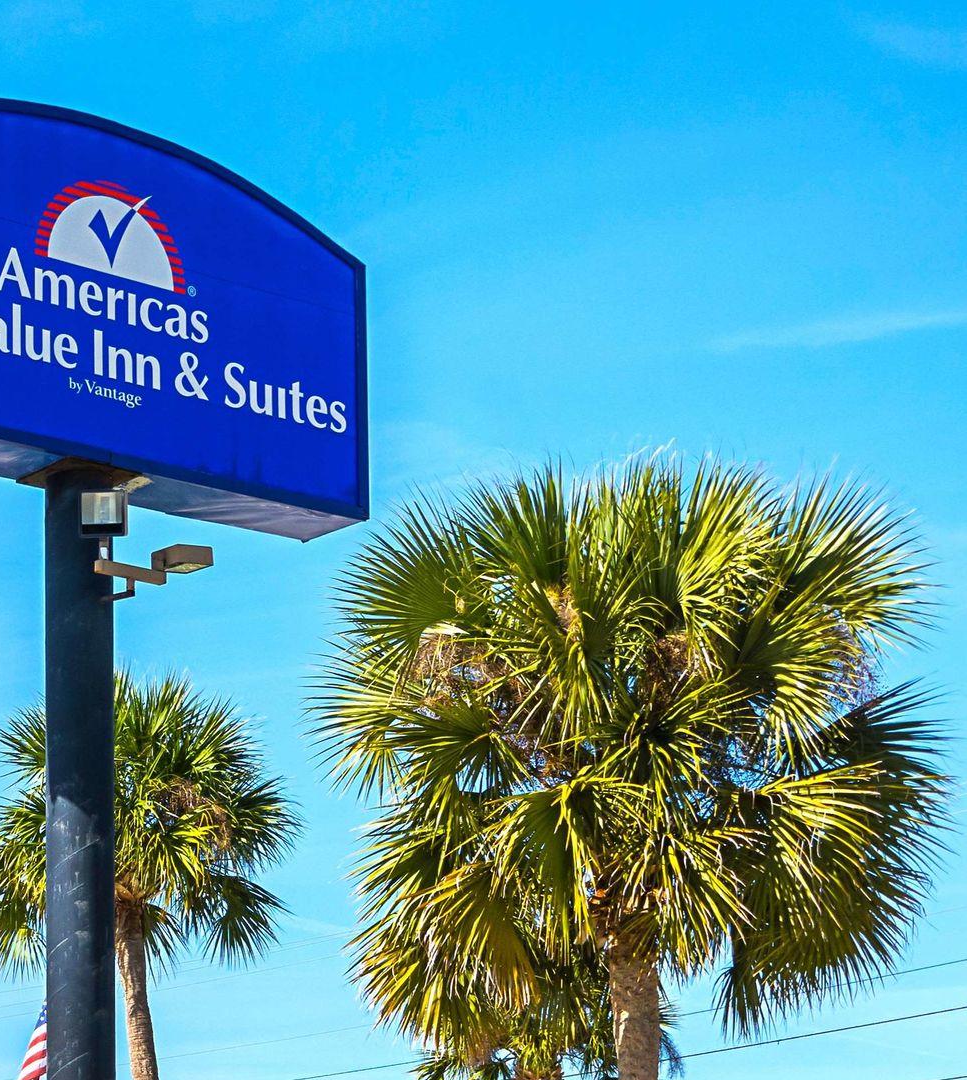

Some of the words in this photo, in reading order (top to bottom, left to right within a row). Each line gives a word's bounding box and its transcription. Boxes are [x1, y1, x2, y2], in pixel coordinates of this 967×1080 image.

[69, 377, 83, 393] by
[84, 378, 143, 408] Vantage
[93, 328, 161, 391] Inn
[174, 351, 209, 401] &
[224, 361, 347, 434] Suites
